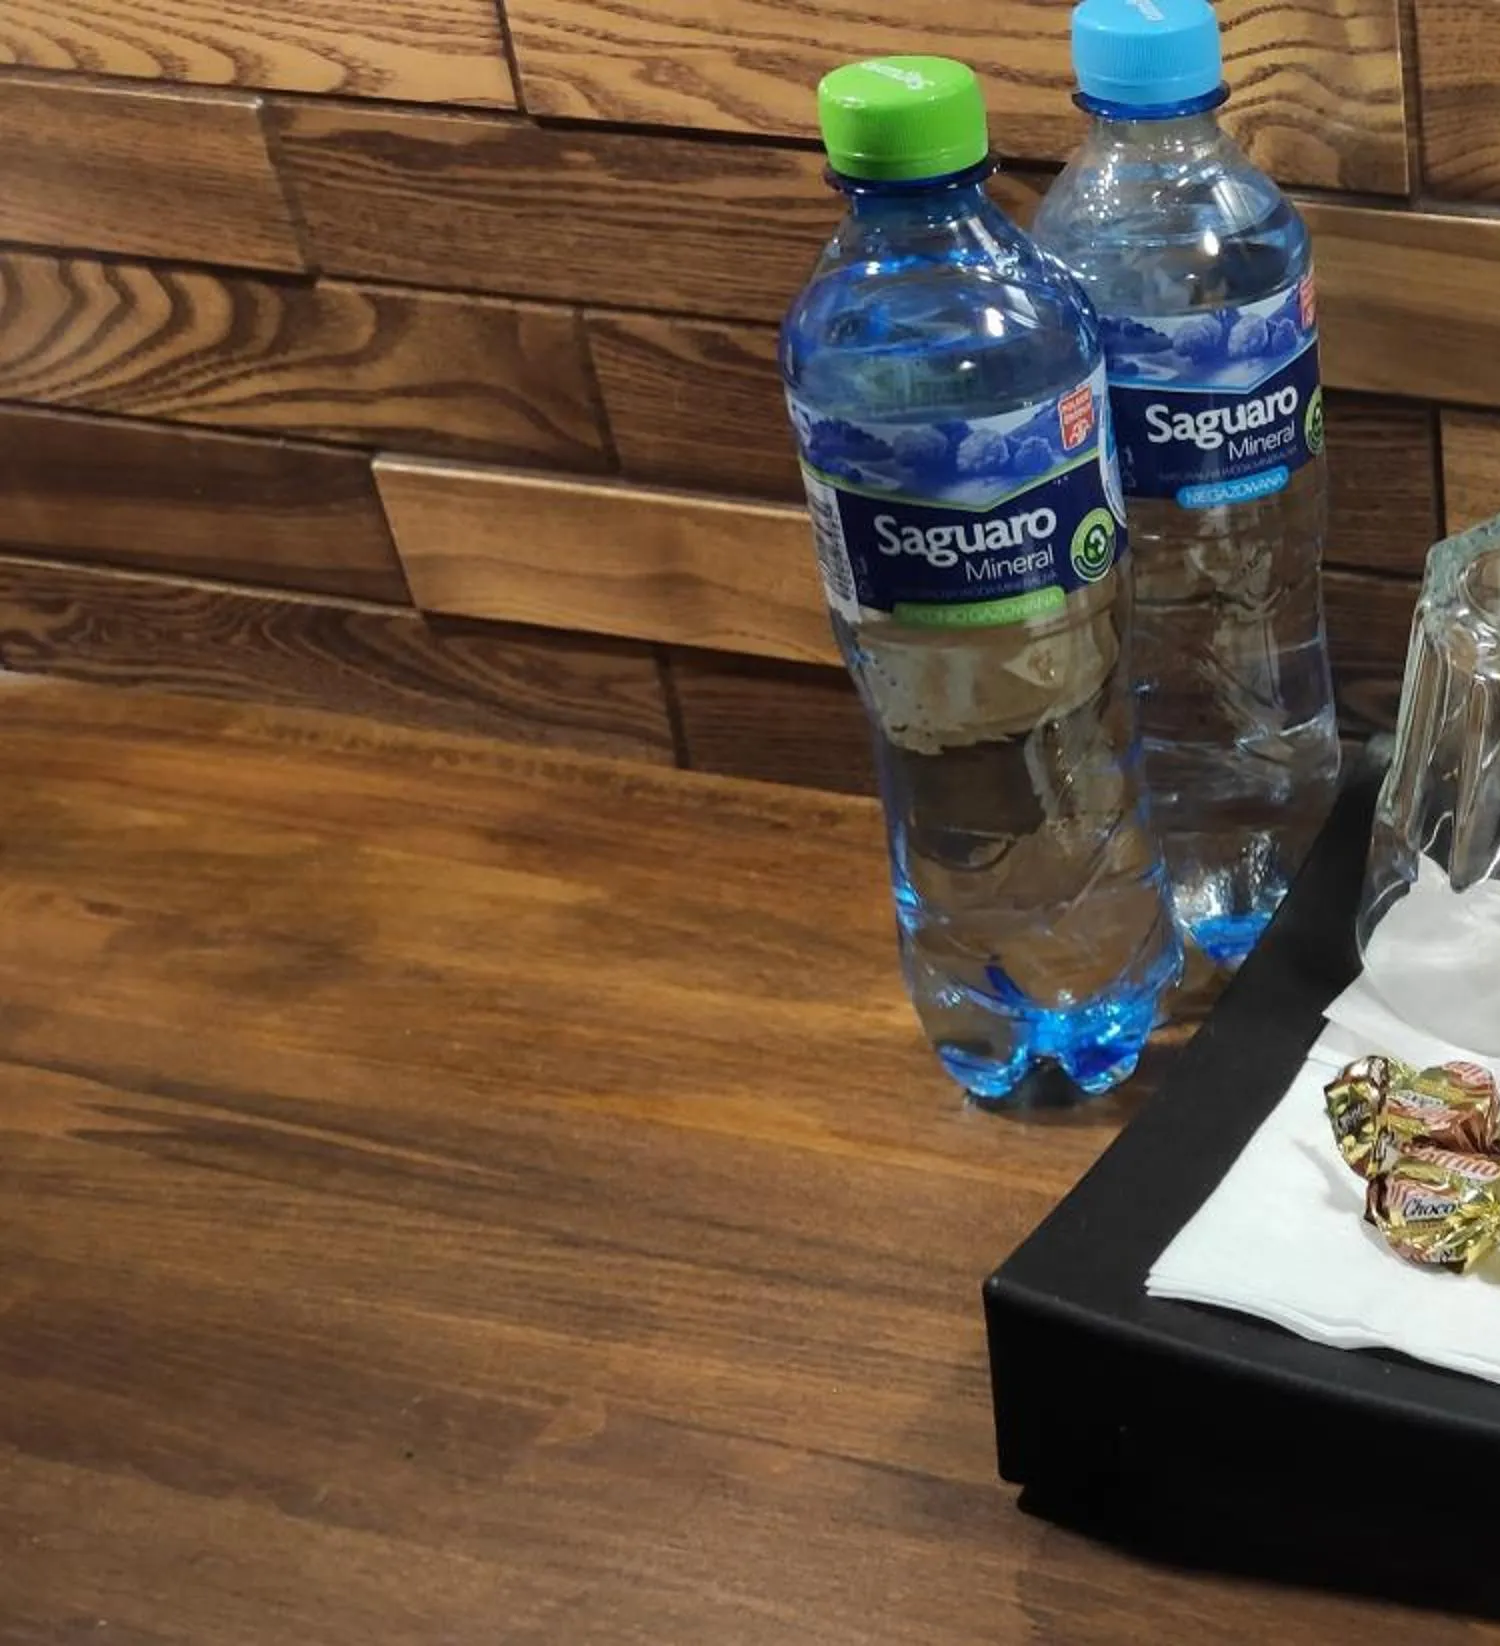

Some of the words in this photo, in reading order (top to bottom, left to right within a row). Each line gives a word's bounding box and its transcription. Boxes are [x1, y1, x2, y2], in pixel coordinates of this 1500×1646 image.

[1145, 385, 1299, 450] Saguaro
[1229, 420, 1296, 461] Mineral
[873, 507, 1058, 568] Saguaro
[965, 544, 1055, 582] Mineral
[1403, 1198, 1457, 1217] Choco
